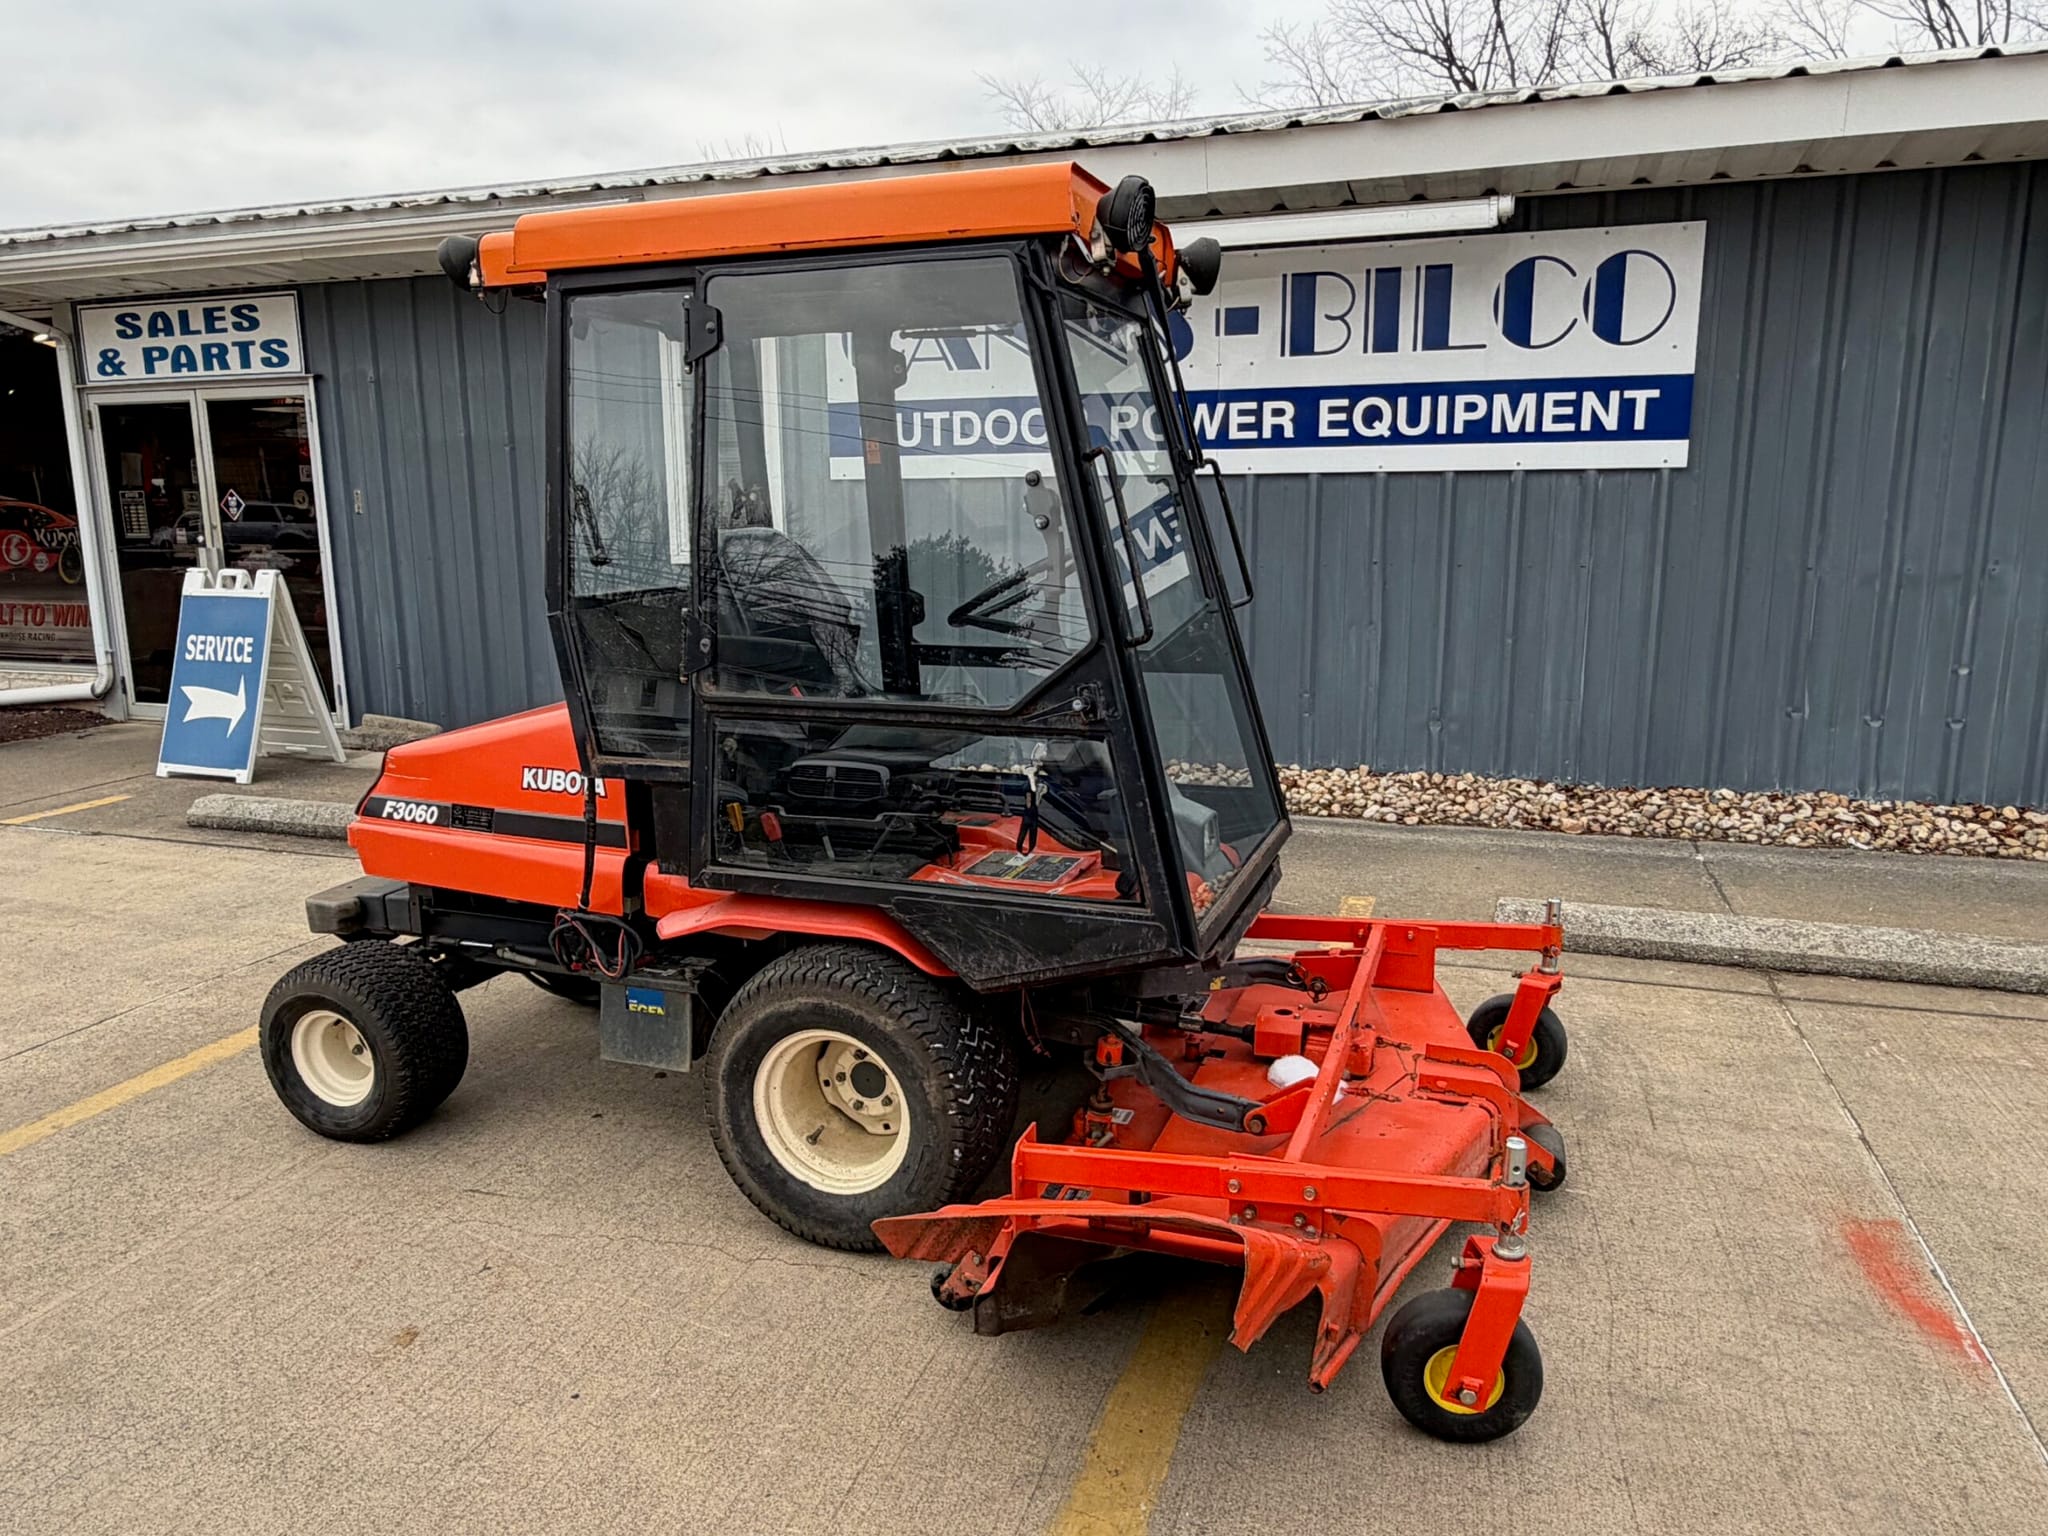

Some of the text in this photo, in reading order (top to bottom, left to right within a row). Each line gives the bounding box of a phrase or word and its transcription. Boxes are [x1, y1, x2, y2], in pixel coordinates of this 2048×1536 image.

[114, 303, 261, 340] SALES
[96, 338, 290, 377] & PARTS
[1318, 388, 1660, 439] EQUIPMENT
[21, 602, 46, 627] TO
[184, 634, 255, 664] SERVICE
[381, 800, 439, 825] F3060
